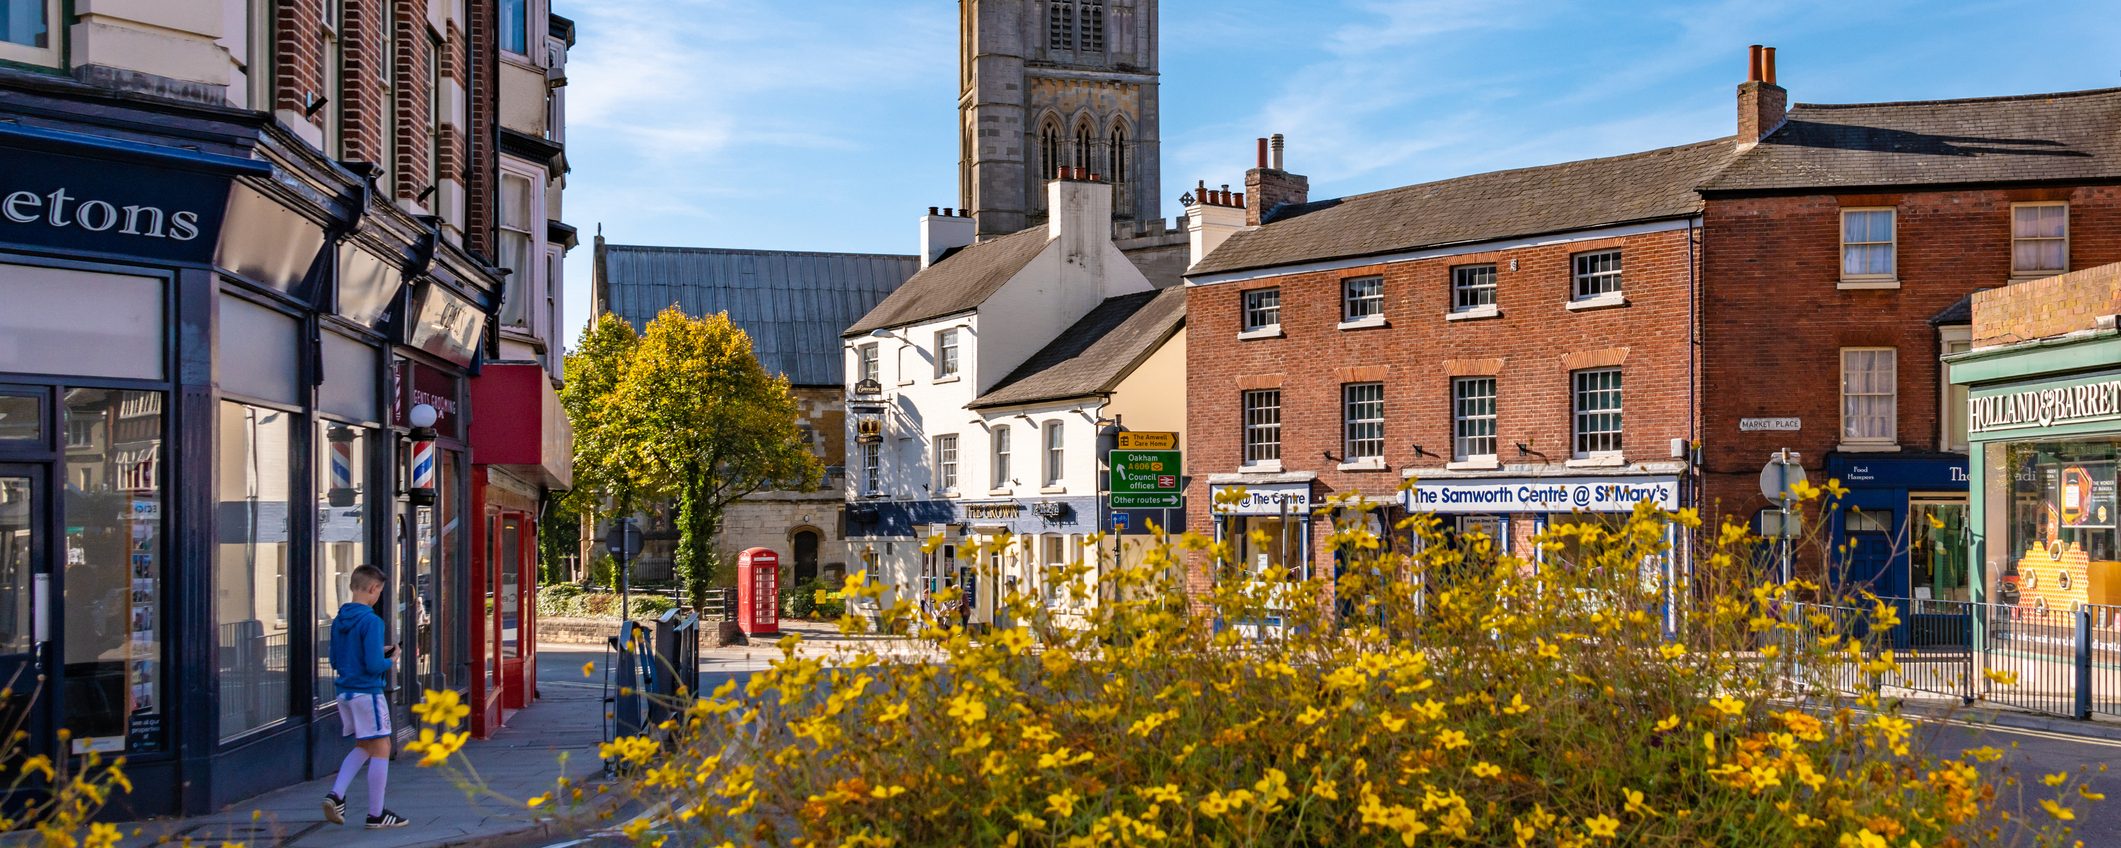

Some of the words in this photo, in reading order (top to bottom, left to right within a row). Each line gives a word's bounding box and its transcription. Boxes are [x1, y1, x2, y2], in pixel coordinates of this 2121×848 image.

[1, 187, 200, 241] etons
[1742, 420, 1770, 428] MARKET
[1775, 420, 1799, 428] PLACE
[1128, 454, 1158, 462] Oakham
[1128, 473, 1157, 481] Council
[1129, 481, 1155, 489] offices
[1252, 492, 1270, 505] The
[1413, 487, 1438, 503] The
[1441, 486, 1513, 503] Samworth
[1517, 486, 1568, 503] Centre
[1572, 485, 1591, 507] @
[1594, 484, 1609, 502] St
[1113, 496, 1134, 504] Other
[1136, 496, 1161, 504] routes
